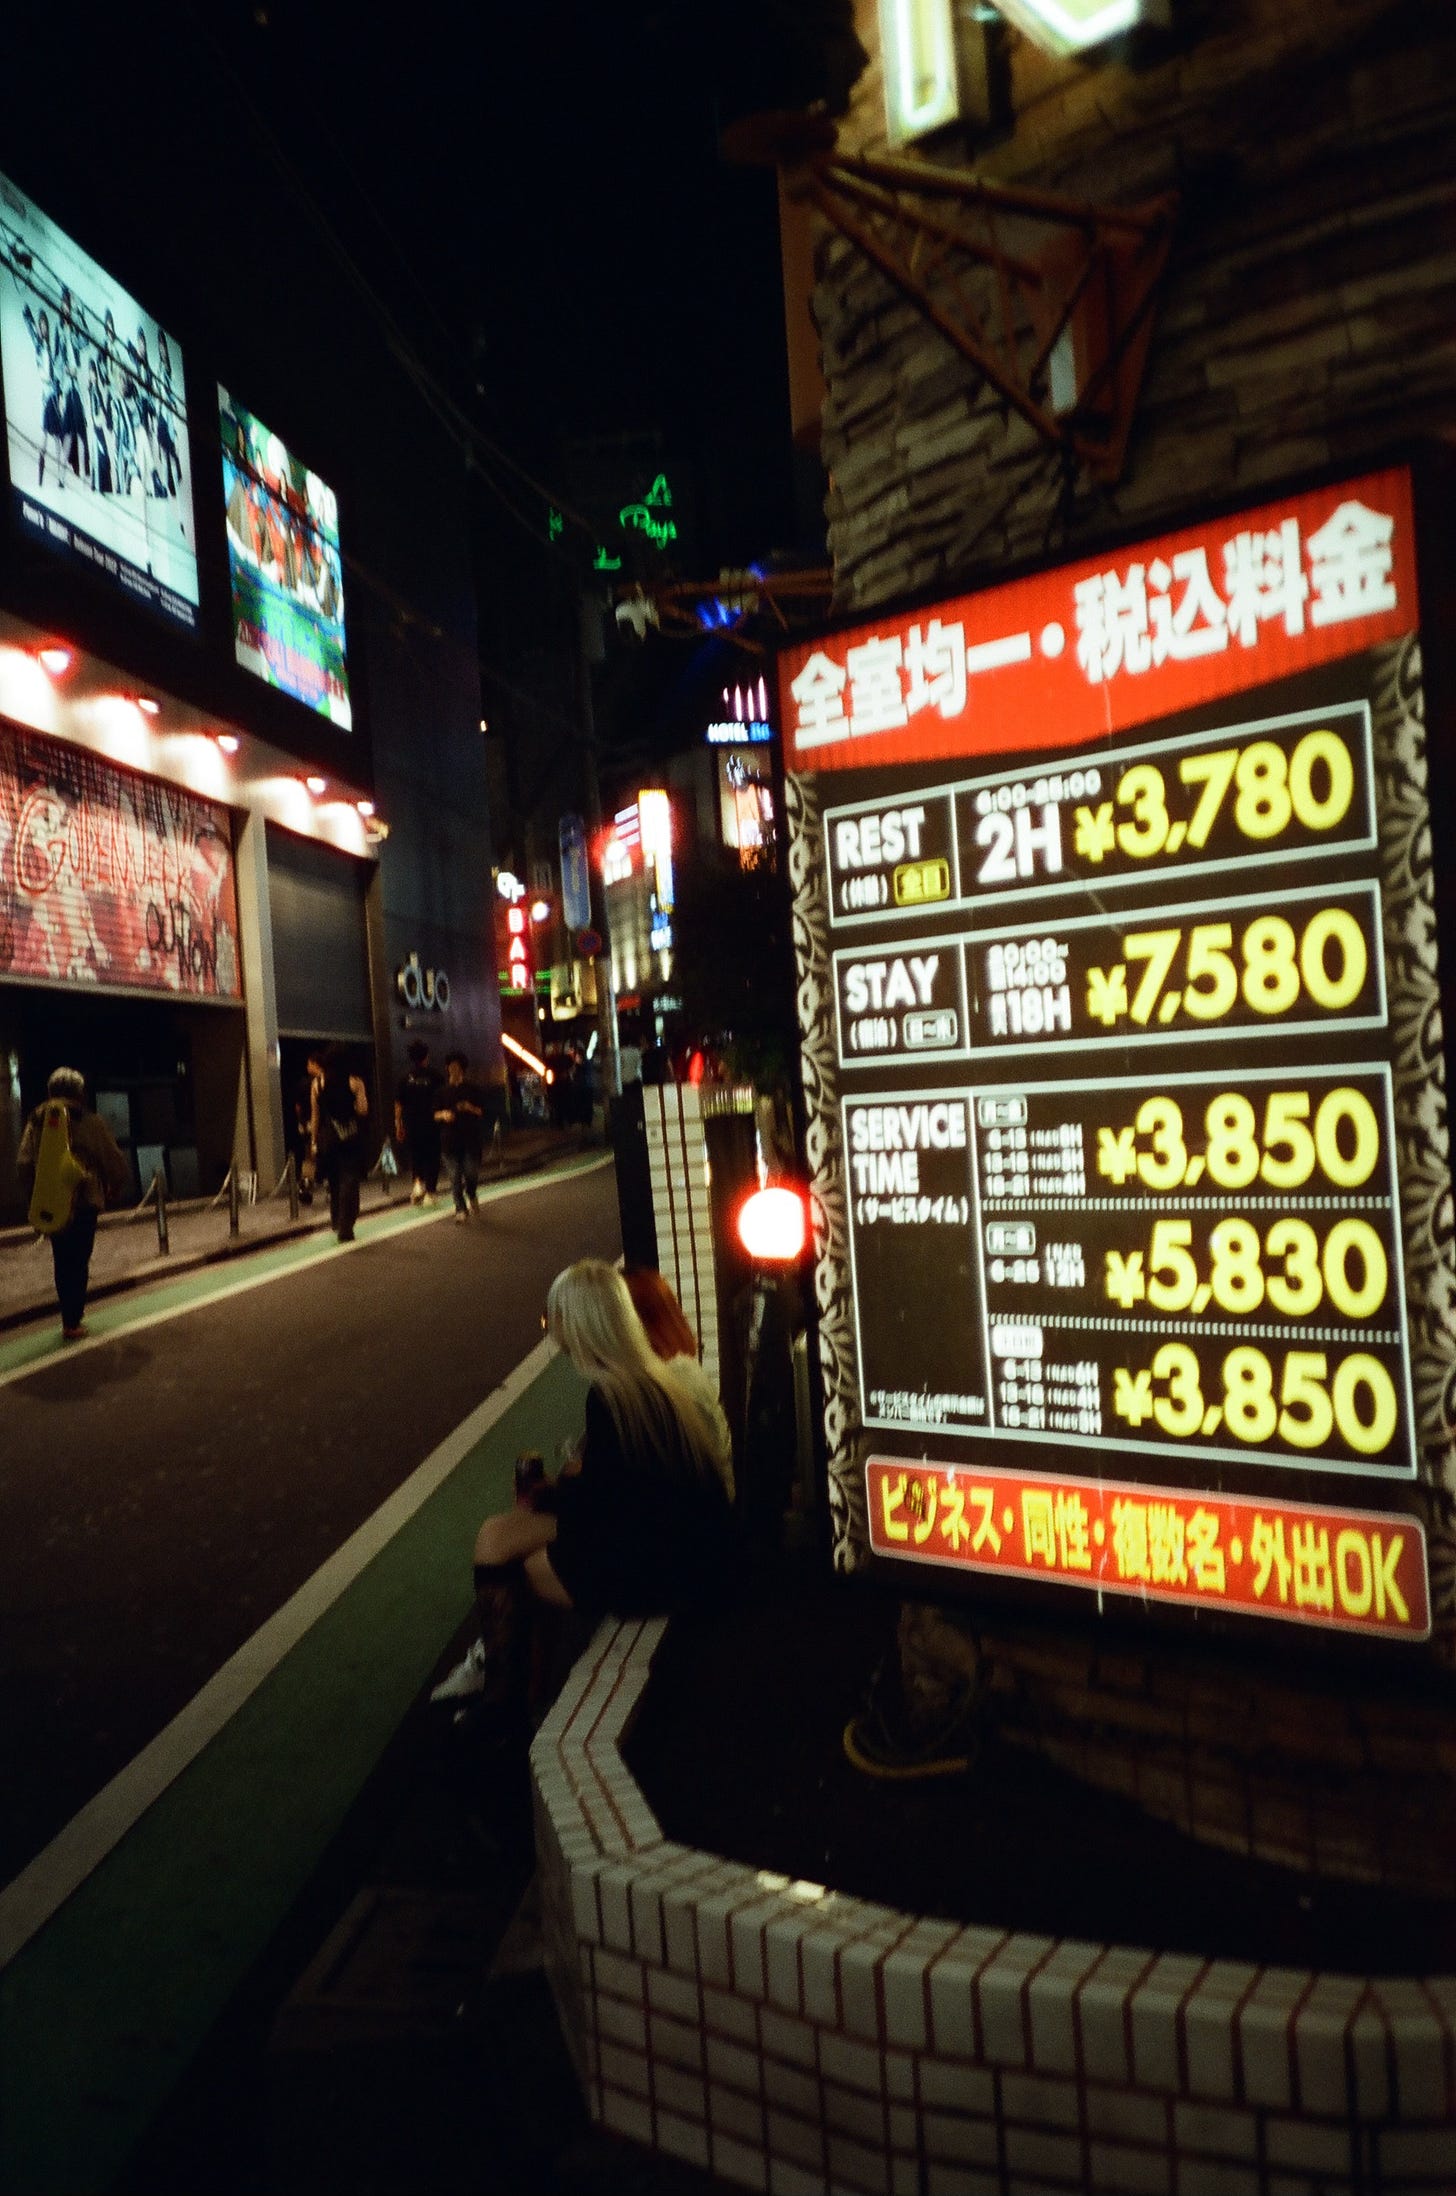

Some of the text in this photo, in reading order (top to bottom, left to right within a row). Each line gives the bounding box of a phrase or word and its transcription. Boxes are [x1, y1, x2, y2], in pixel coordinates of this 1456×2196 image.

[837, 806, 925, 870] REST
[976, 801, 1062, 884] 2H
[1075, 731, 1354, 863] ¥3,780
[846, 955, 939, 1013] STAY
[1087, 909, 1367, 1026] ¥7,580
[852, 1103, 966, 1151] SERVICE
[853, 1151, 920, 1194] TIME
[1098, 1088, 1379, 1190] ¥3,850
[1106, 1218, 1388, 1318] ¥5,830
[1115, 1343, 1397, 1454] ¥3,850
